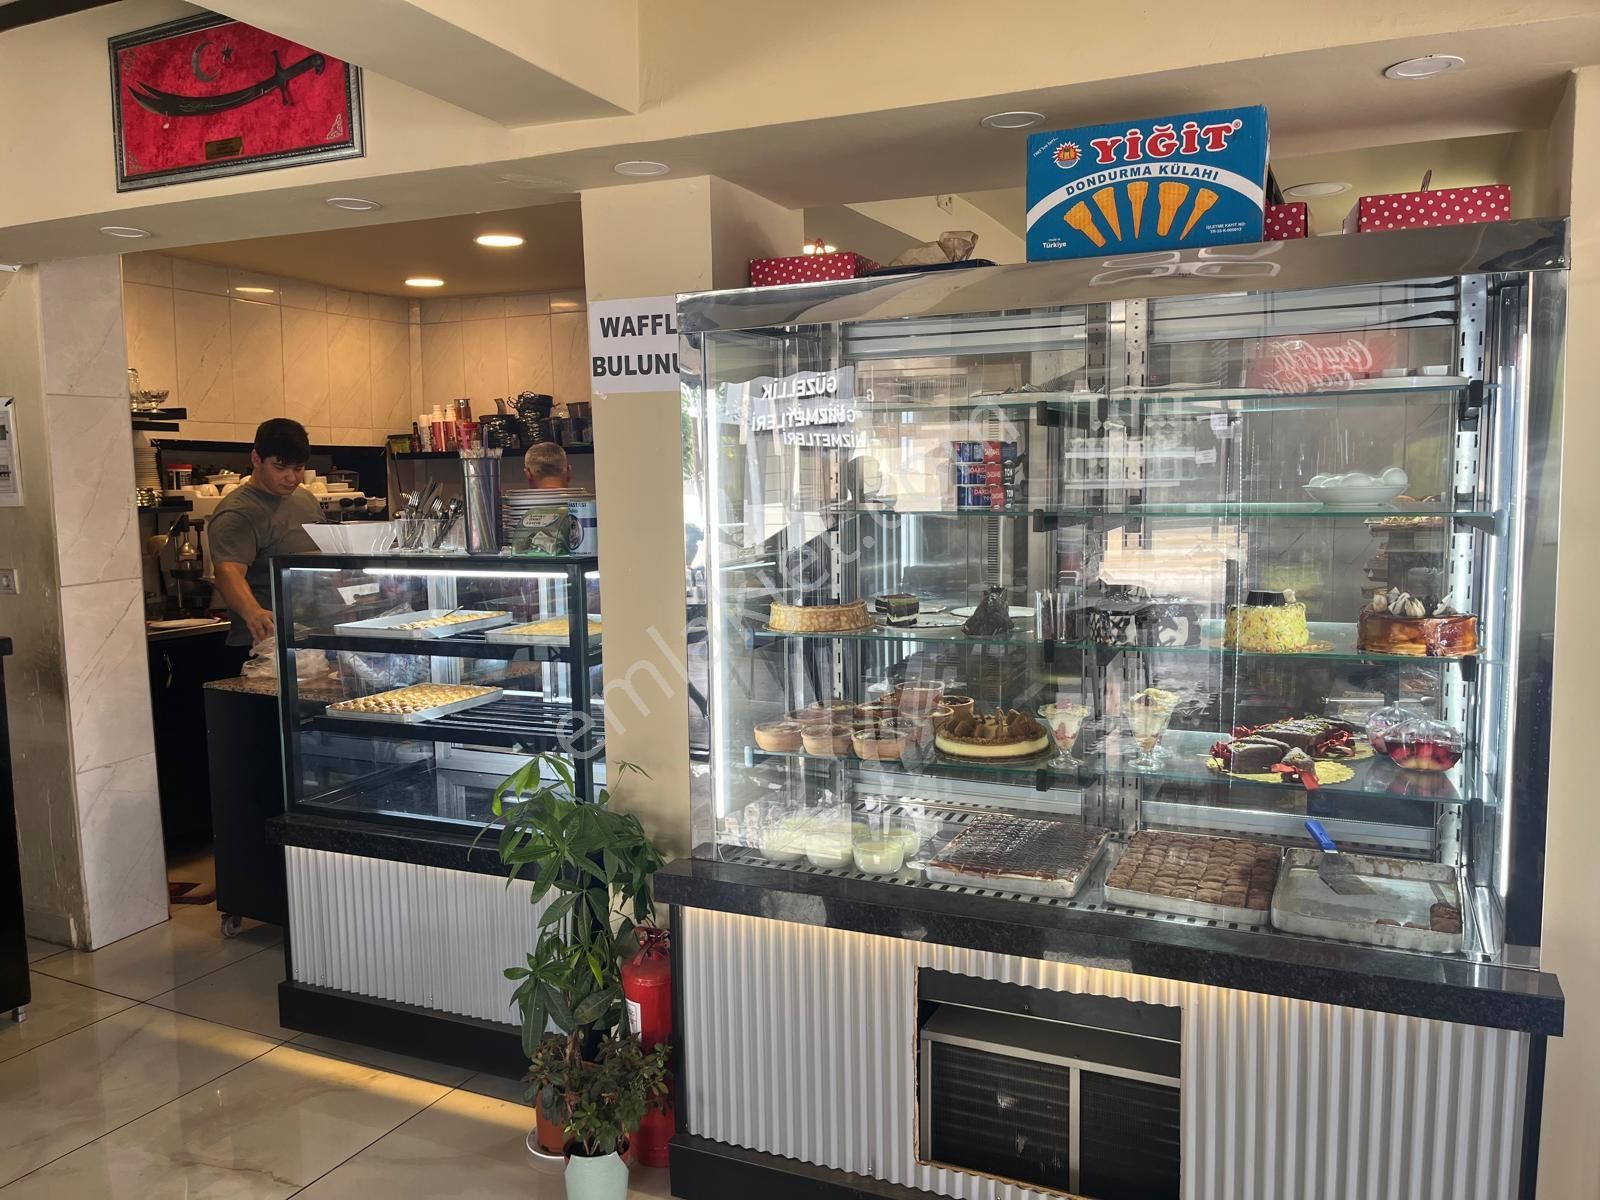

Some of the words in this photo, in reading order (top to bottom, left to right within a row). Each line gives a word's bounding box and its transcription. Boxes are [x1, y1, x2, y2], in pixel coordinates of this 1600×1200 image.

[1065, 164, 1152, 197] DONDURMA
[1158, 162, 1220, 182] KÜLAHI
[1042, 241, 1067, 249] Türkiye
